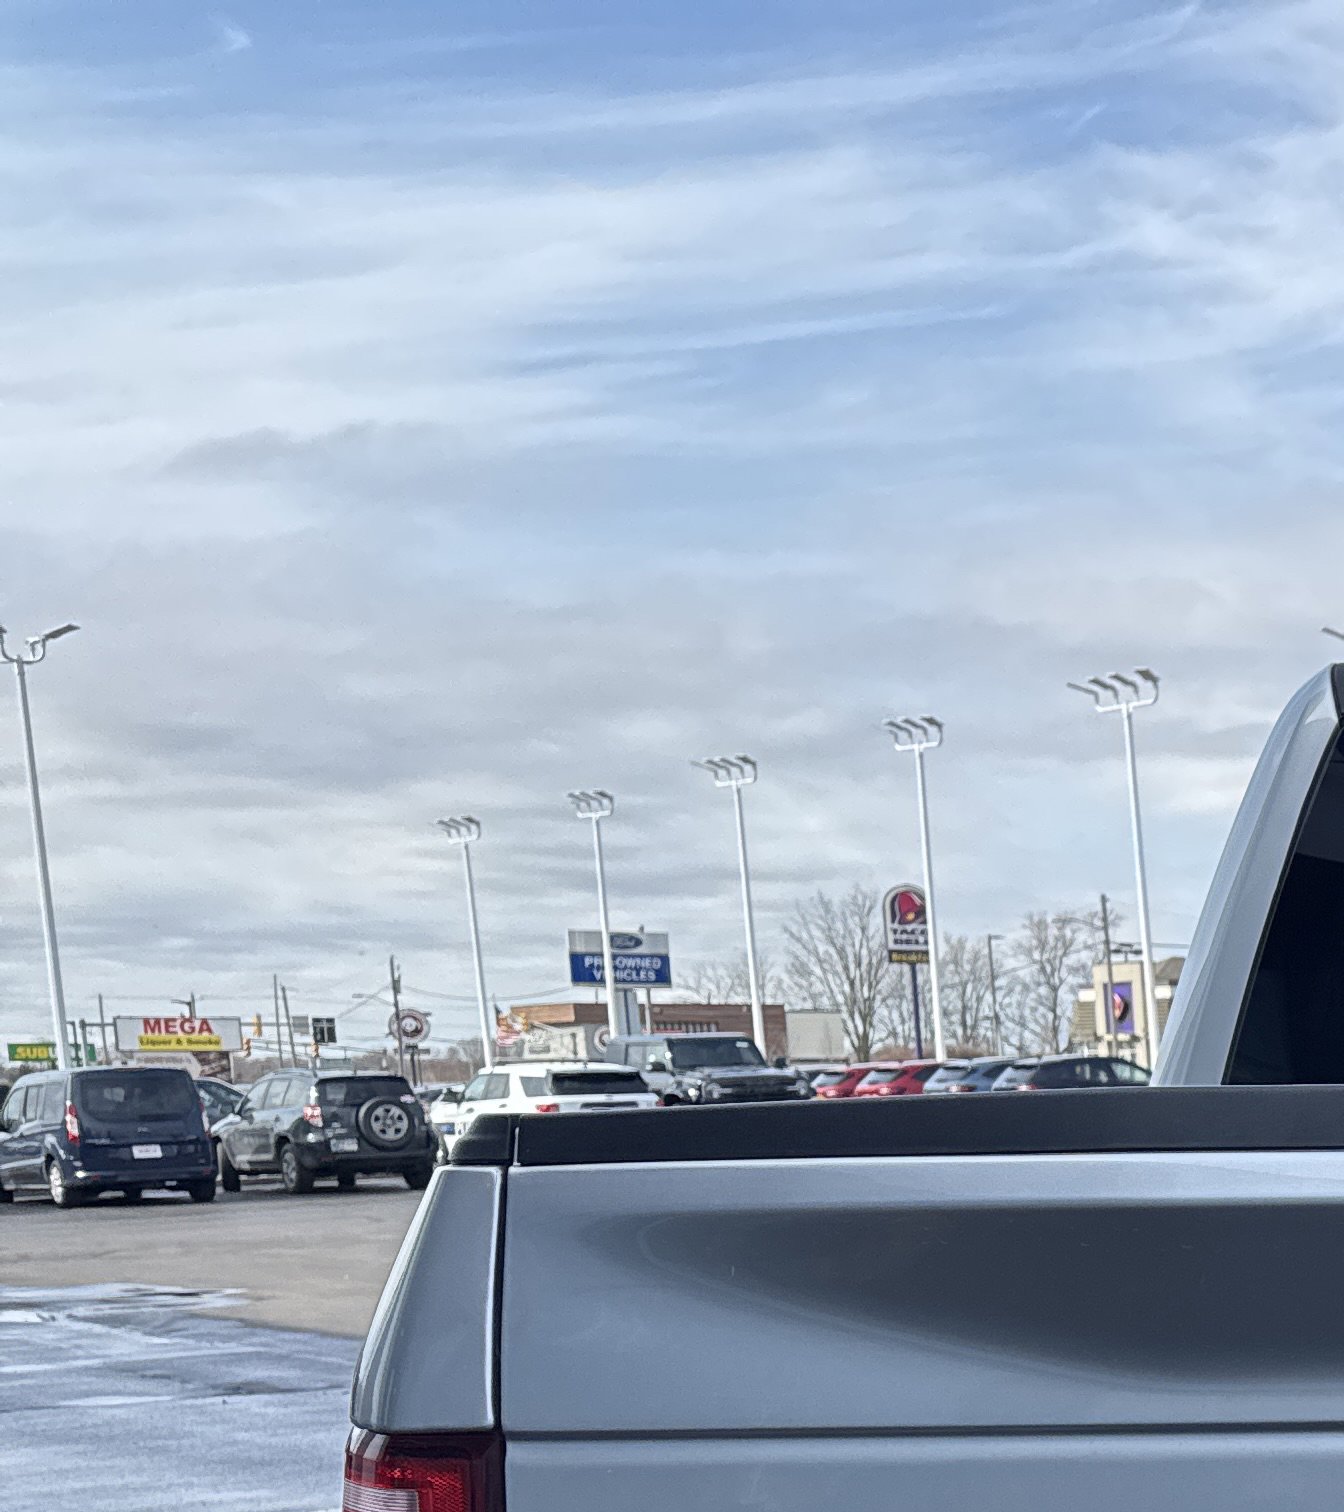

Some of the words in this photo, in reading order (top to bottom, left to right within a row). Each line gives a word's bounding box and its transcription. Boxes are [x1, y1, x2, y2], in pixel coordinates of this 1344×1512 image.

[584, 955, 662, 970] PROWNED
[592, 968, 657, 982] VICLES
[143, 1018, 214, 1035] MEGA
